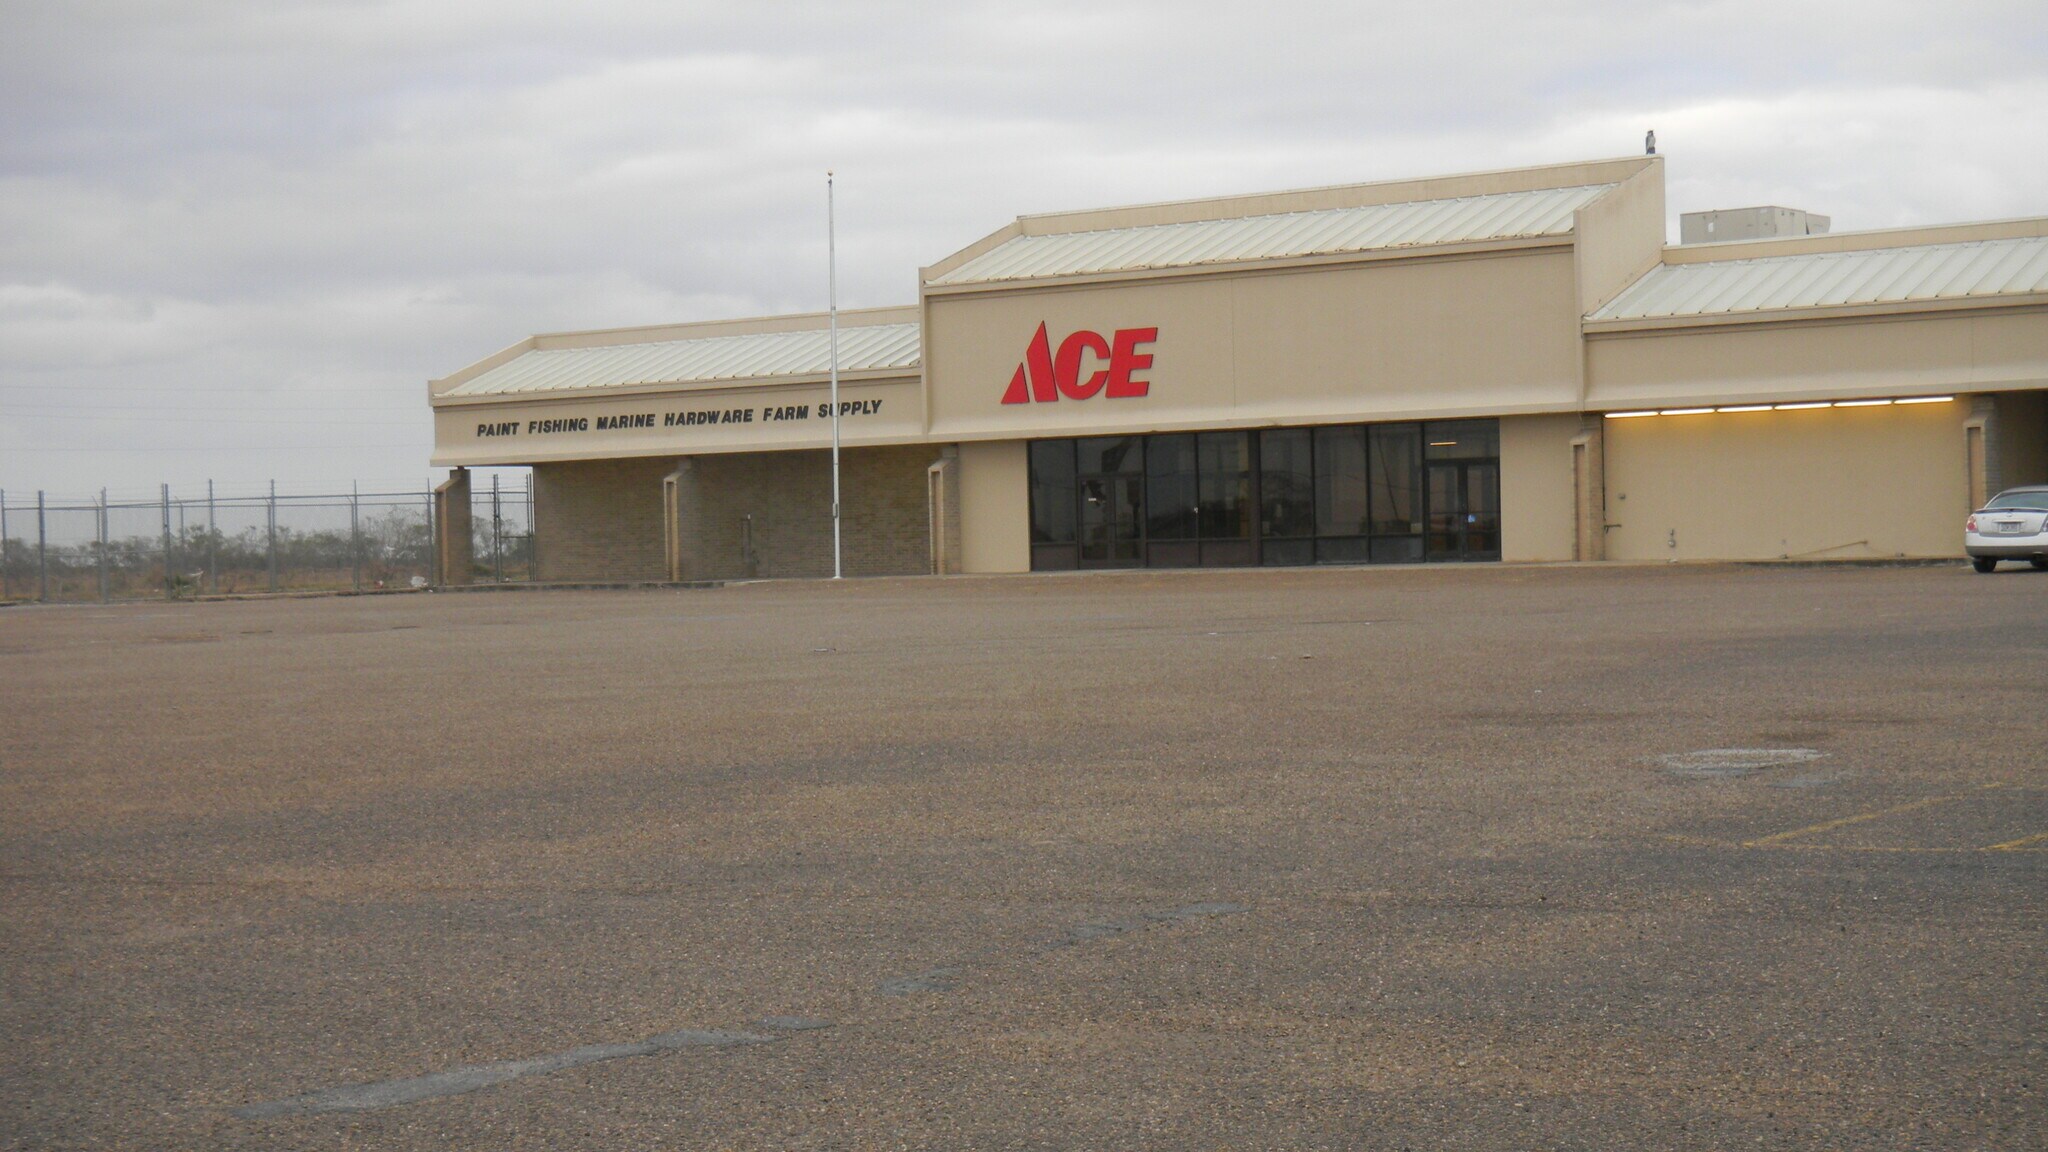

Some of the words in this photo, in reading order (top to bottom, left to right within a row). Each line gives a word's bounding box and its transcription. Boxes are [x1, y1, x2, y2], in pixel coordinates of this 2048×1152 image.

[1001, 320, 1158, 404] ACE
[477, 422, 520, 437] PAINT
[528, 418, 589, 434] FISHING
[596, 413, 656, 430] MARINE
[664, 408, 754, 427] HARDWARE
[763, 405, 809, 421] FARM
